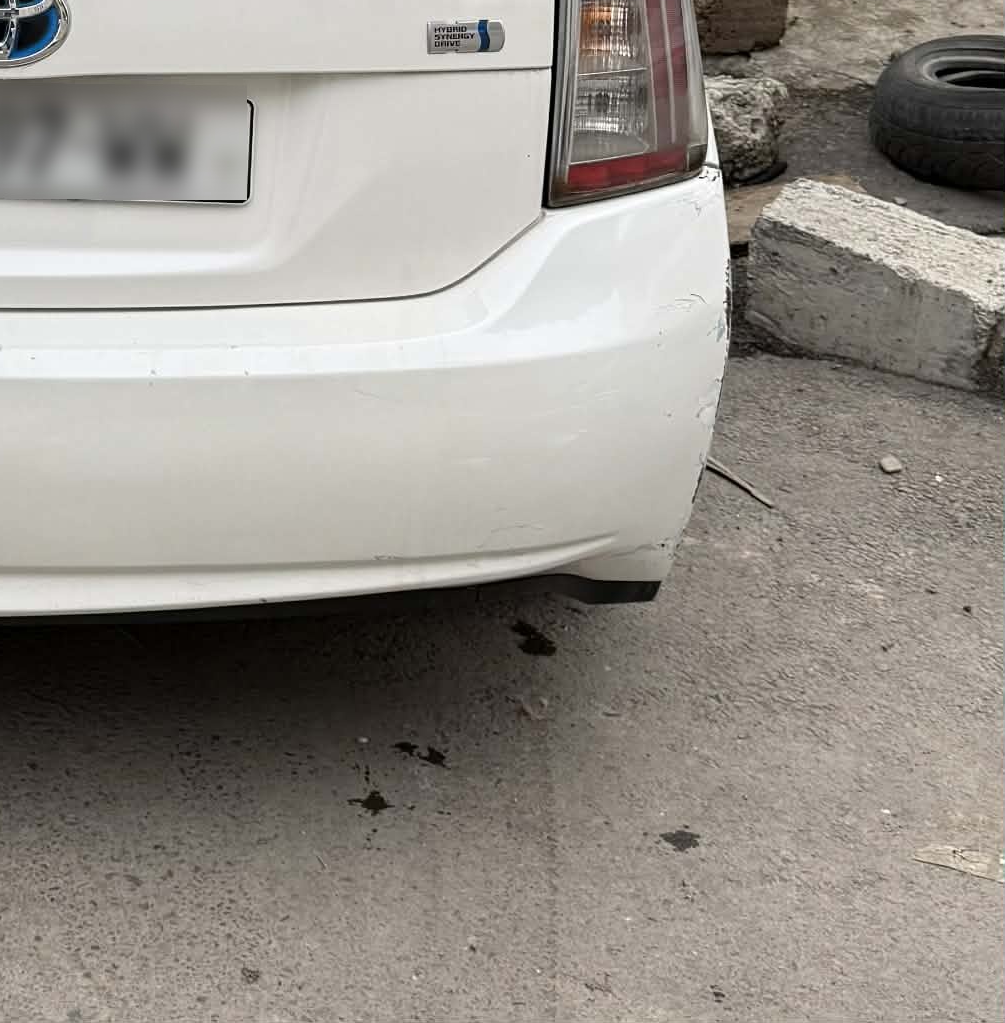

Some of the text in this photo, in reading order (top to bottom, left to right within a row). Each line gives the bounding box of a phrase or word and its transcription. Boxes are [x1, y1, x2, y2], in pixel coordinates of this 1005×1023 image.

[434, 25, 468, 34] HYBRID
[434, 33, 475, 41] SYNERGY
[434, 40, 461, 48] DRIVE
